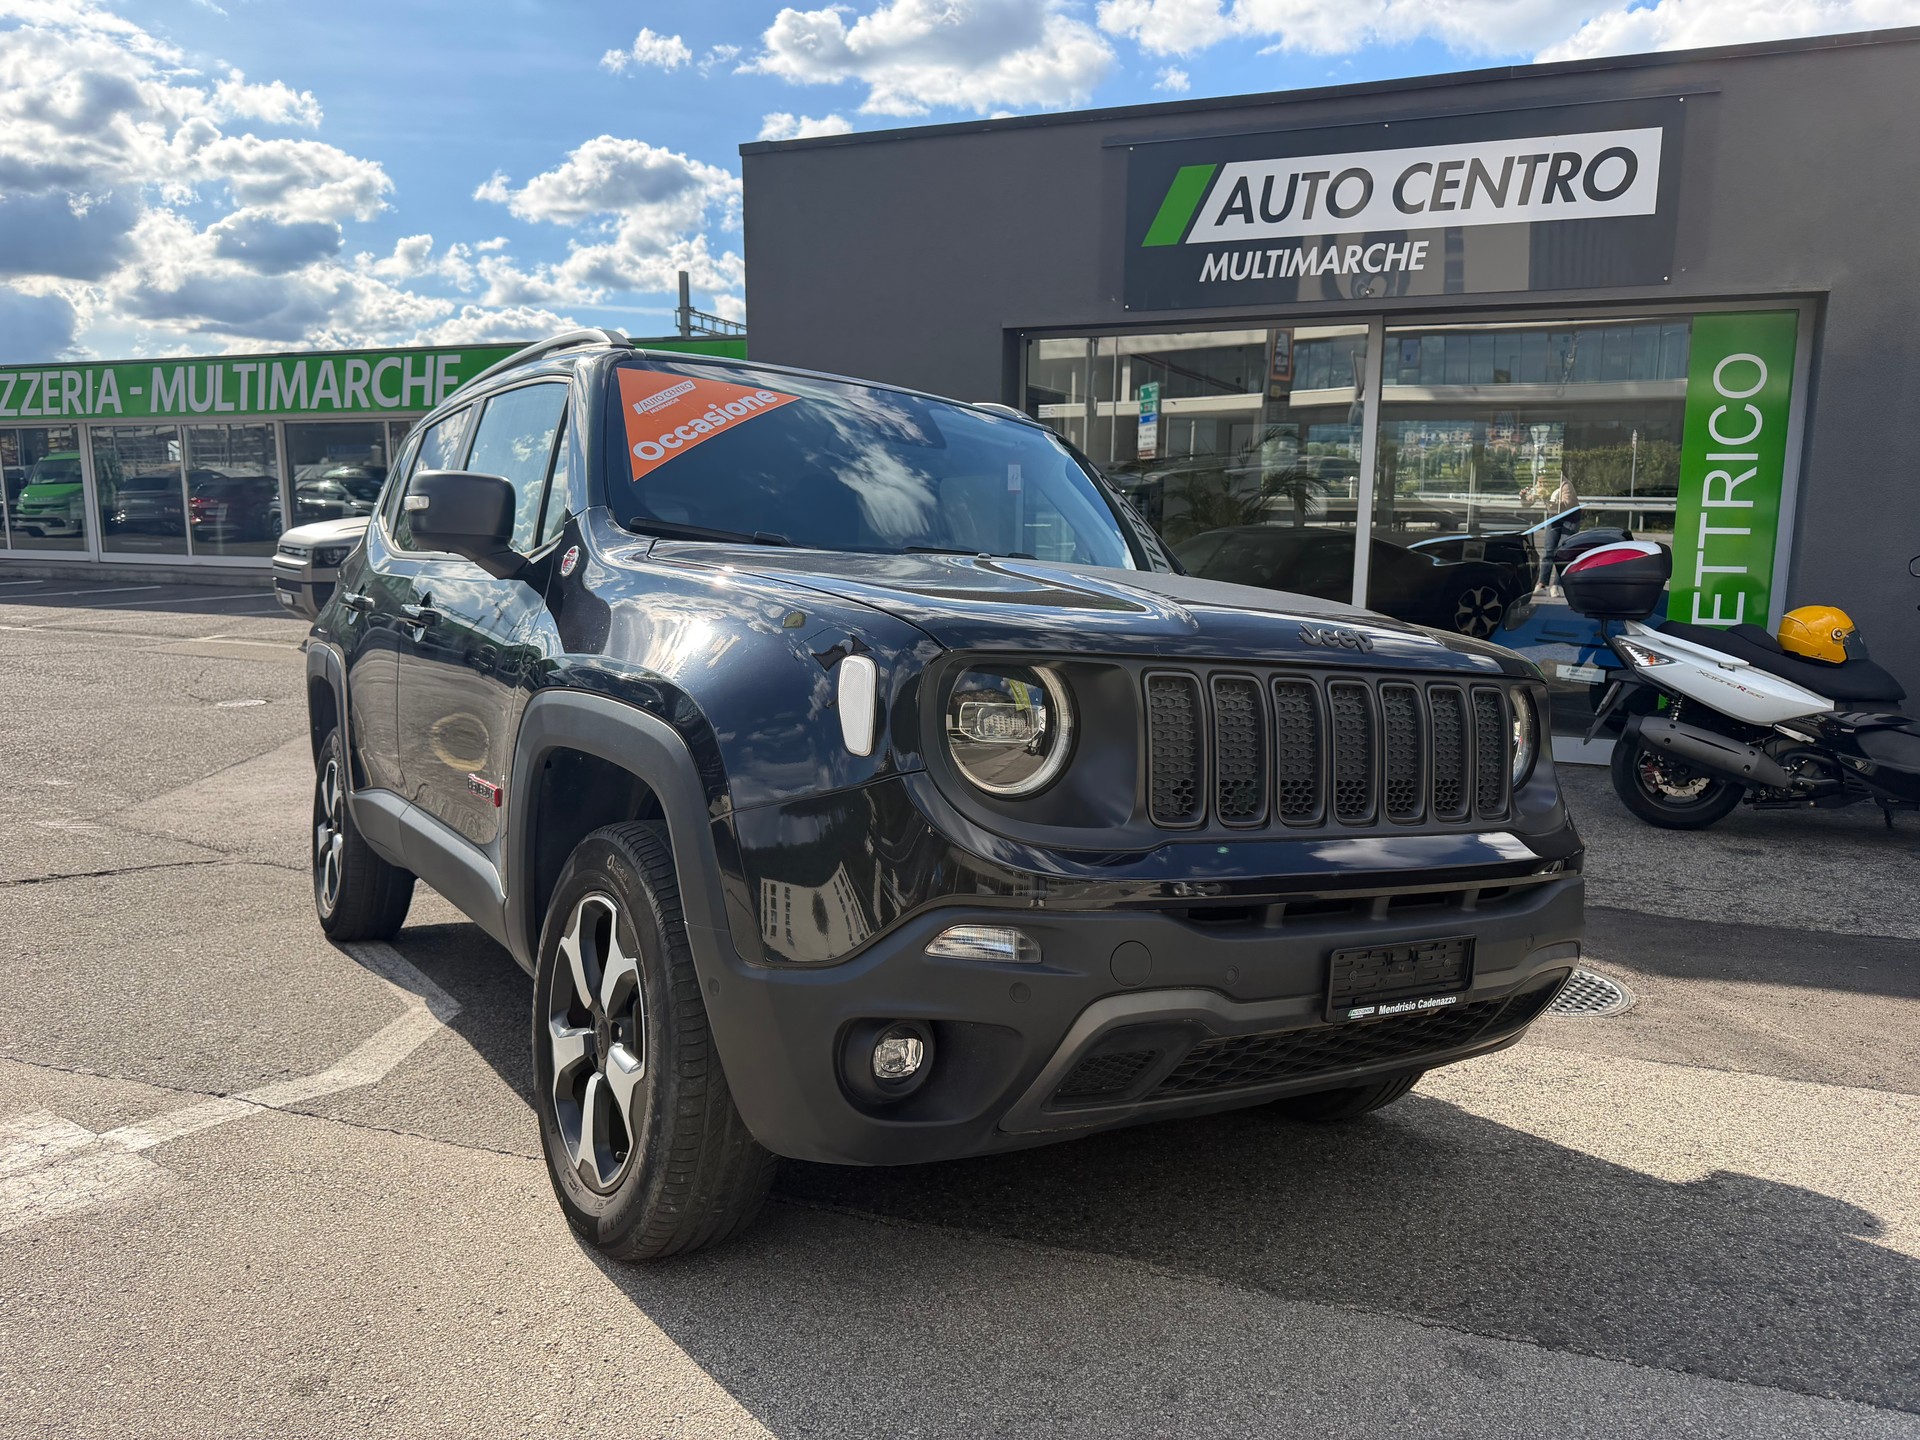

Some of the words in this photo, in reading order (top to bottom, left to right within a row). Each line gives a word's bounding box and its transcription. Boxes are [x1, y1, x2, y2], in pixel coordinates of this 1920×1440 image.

[1214, 166, 1374, 227] AUTO
[1392, 146, 1640, 215] CENTRO
[1199, 239, 1430, 283] MULTIMARCHE
[150, 354, 462, 413] MULTIMARCHE
[643, 395, 665, 408] AUTO
[664, 382, 693, 398] CENTRO
[632, 390, 778, 461] Occasione
[1691, 352, 1768, 625] ETTRICO
[1298, 622, 1374, 655] Jeep
[1379, 1001, 1416, 1015] Mendrisio
[1417, 996, 1457, 1009] Cadenazzo
